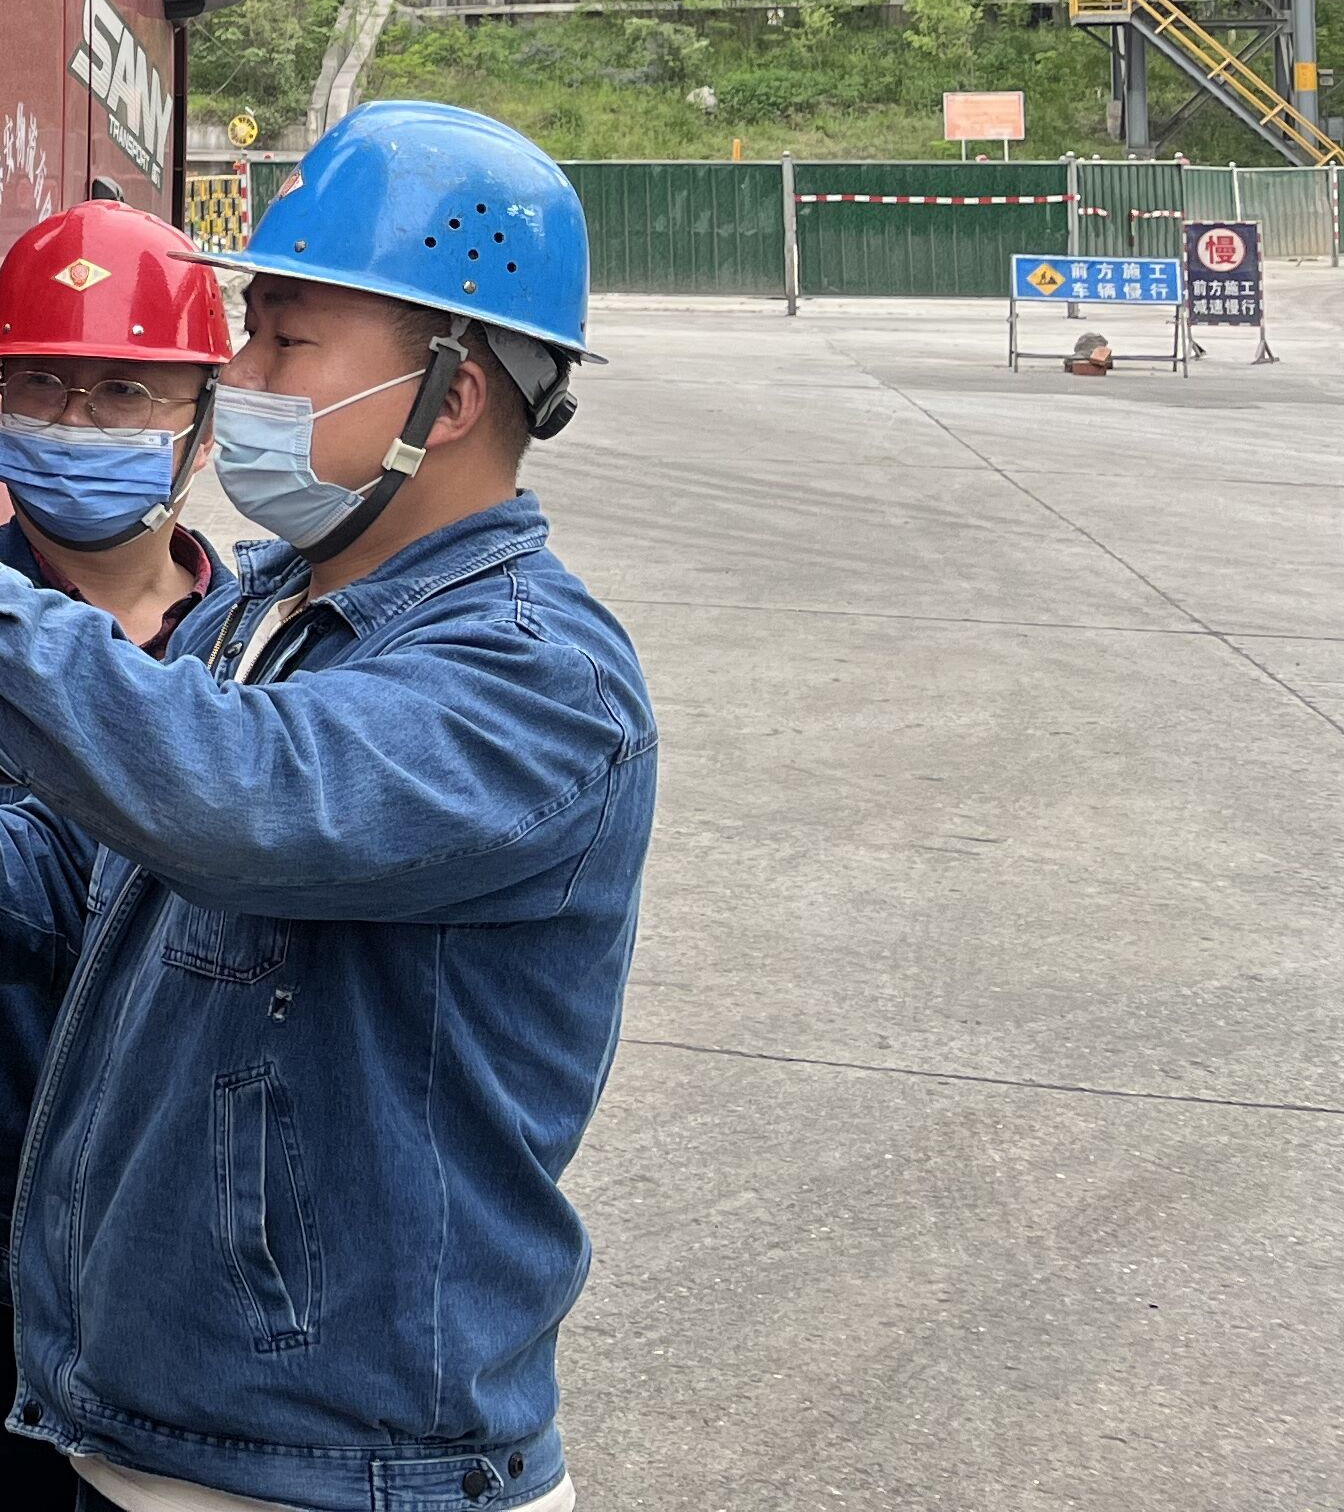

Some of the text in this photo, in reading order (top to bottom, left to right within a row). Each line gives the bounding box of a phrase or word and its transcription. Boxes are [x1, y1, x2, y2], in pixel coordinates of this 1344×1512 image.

[108, 113, 150, 172] TRANSPORT
[1205, 236, 1237, 265] 慢
[1070, 262, 1168, 280] 前方施工
[1071, 282, 1169, 300] 车辆慢行
[1193, 279, 1255, 297] 前方施工
[1193, 299, 1256, 316] 减速慢行
